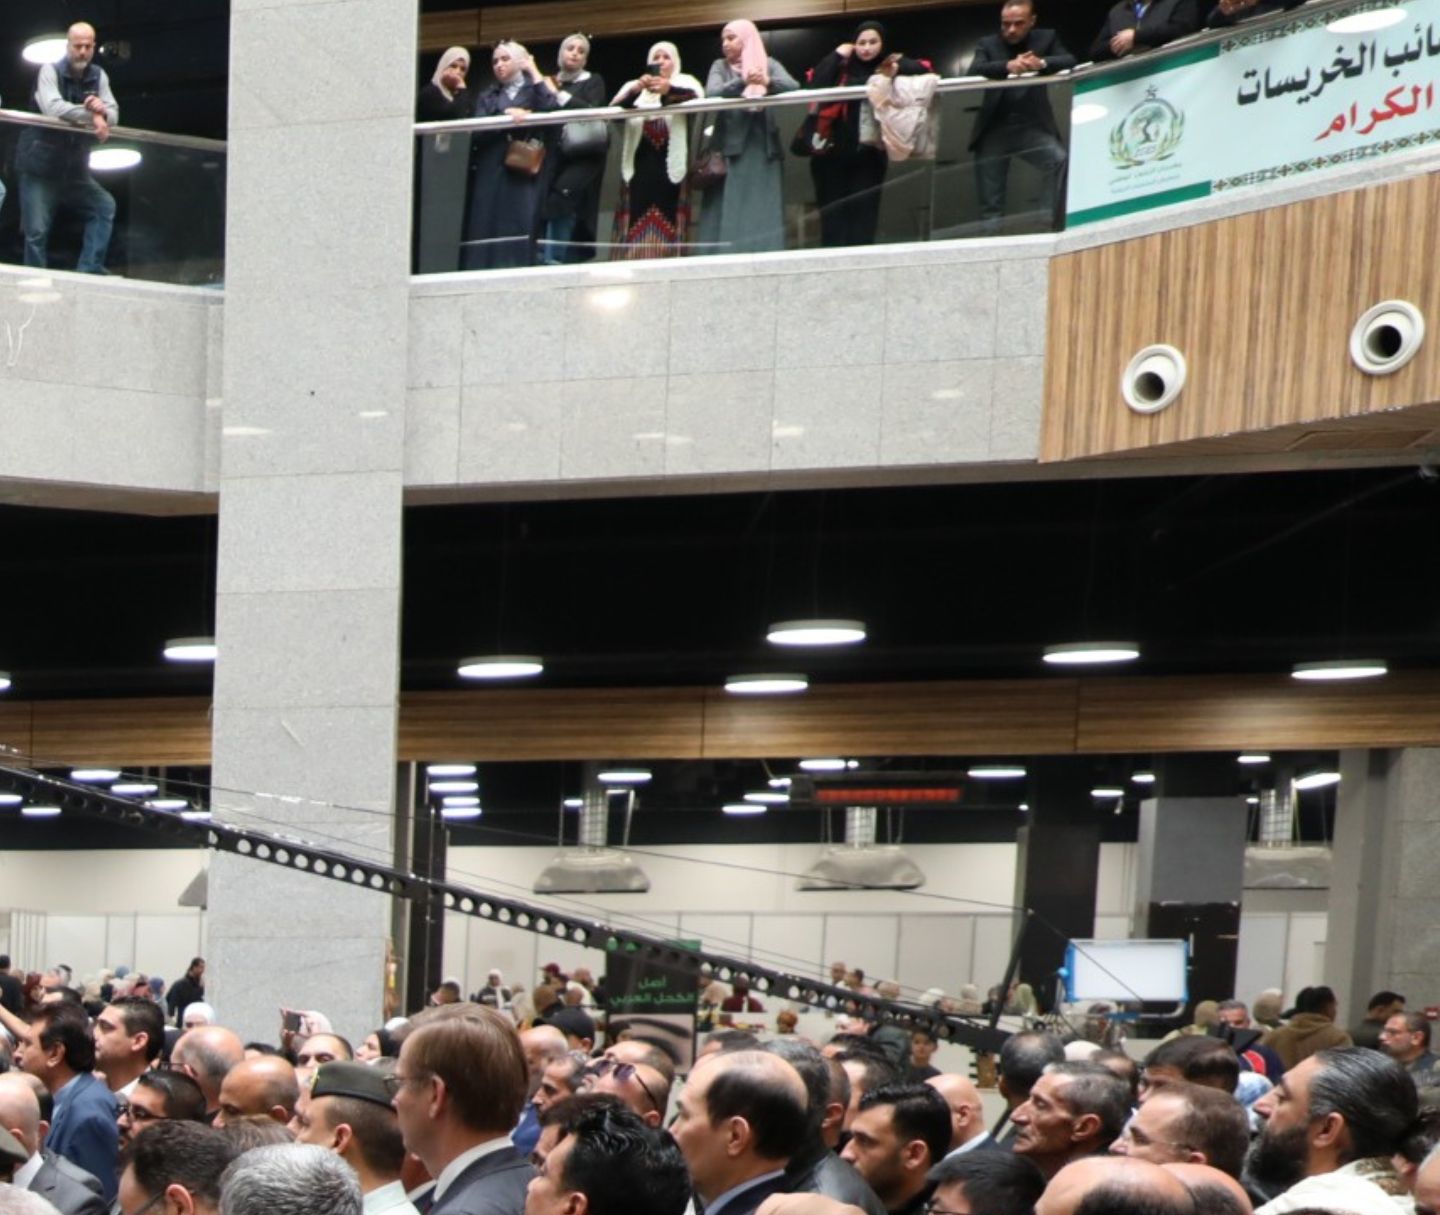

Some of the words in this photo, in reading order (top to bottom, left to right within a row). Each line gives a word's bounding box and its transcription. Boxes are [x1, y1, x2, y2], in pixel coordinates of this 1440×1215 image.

[1237, 39, 1376, 106] الخريسات
[1384, 23, 1440, 77] ائب
[1315, 81, 1434, 142] الكرام
